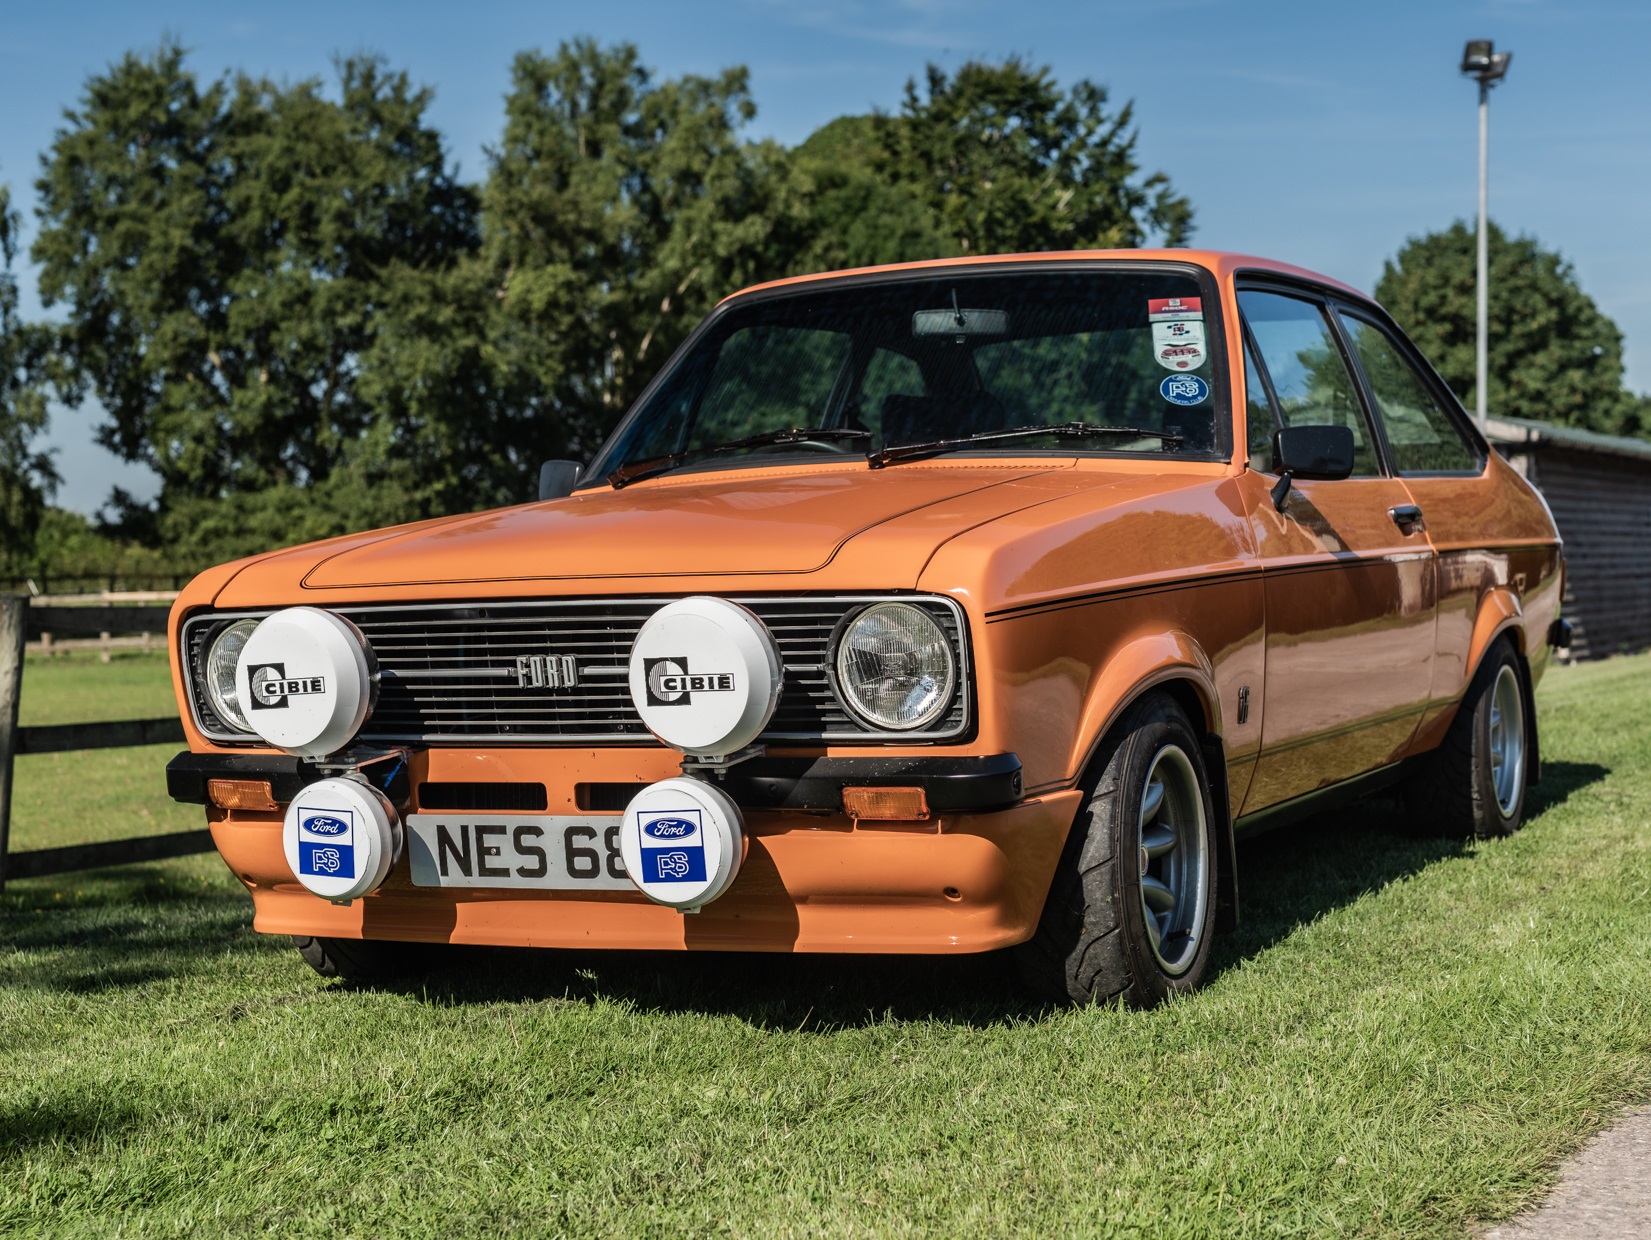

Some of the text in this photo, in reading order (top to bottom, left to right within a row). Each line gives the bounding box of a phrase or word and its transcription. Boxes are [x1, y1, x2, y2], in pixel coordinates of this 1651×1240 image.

[1169, 381, 1199, 397] RS
[516, 654, 578, 689] FORD
[311, 818, 339, 834] Ford
[654, 821, 686, 836] Ford
[312, 848, 340, 873] RS
[436, 824, 548, 879] NES
[657, 851, 689, 878] RS
